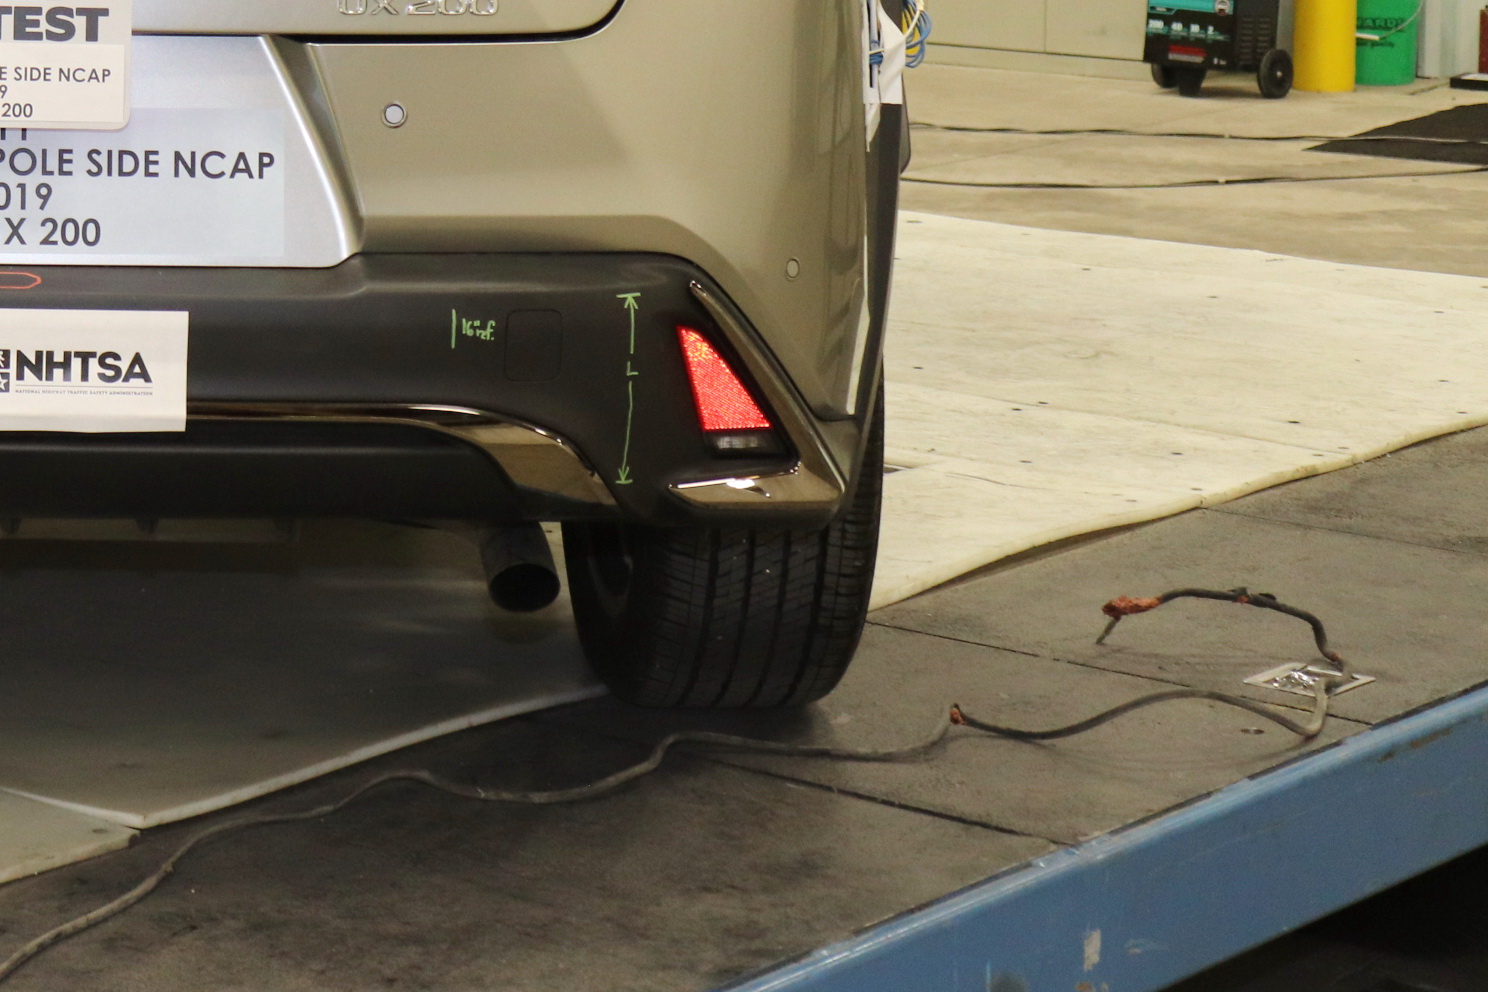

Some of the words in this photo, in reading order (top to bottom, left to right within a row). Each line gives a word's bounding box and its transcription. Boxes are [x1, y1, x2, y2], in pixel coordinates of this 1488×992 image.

[13, 66, 52, 82] SIDE
[58, 67, 111, 83] NCAP
[1, 103, 33, 118] 200
[86, 148, 160, 178] SIDE
[173, 150, 276, 180] NCAP
[39, 217, 101, 247] 200
[16, 350, 152, 382] NHTSA
